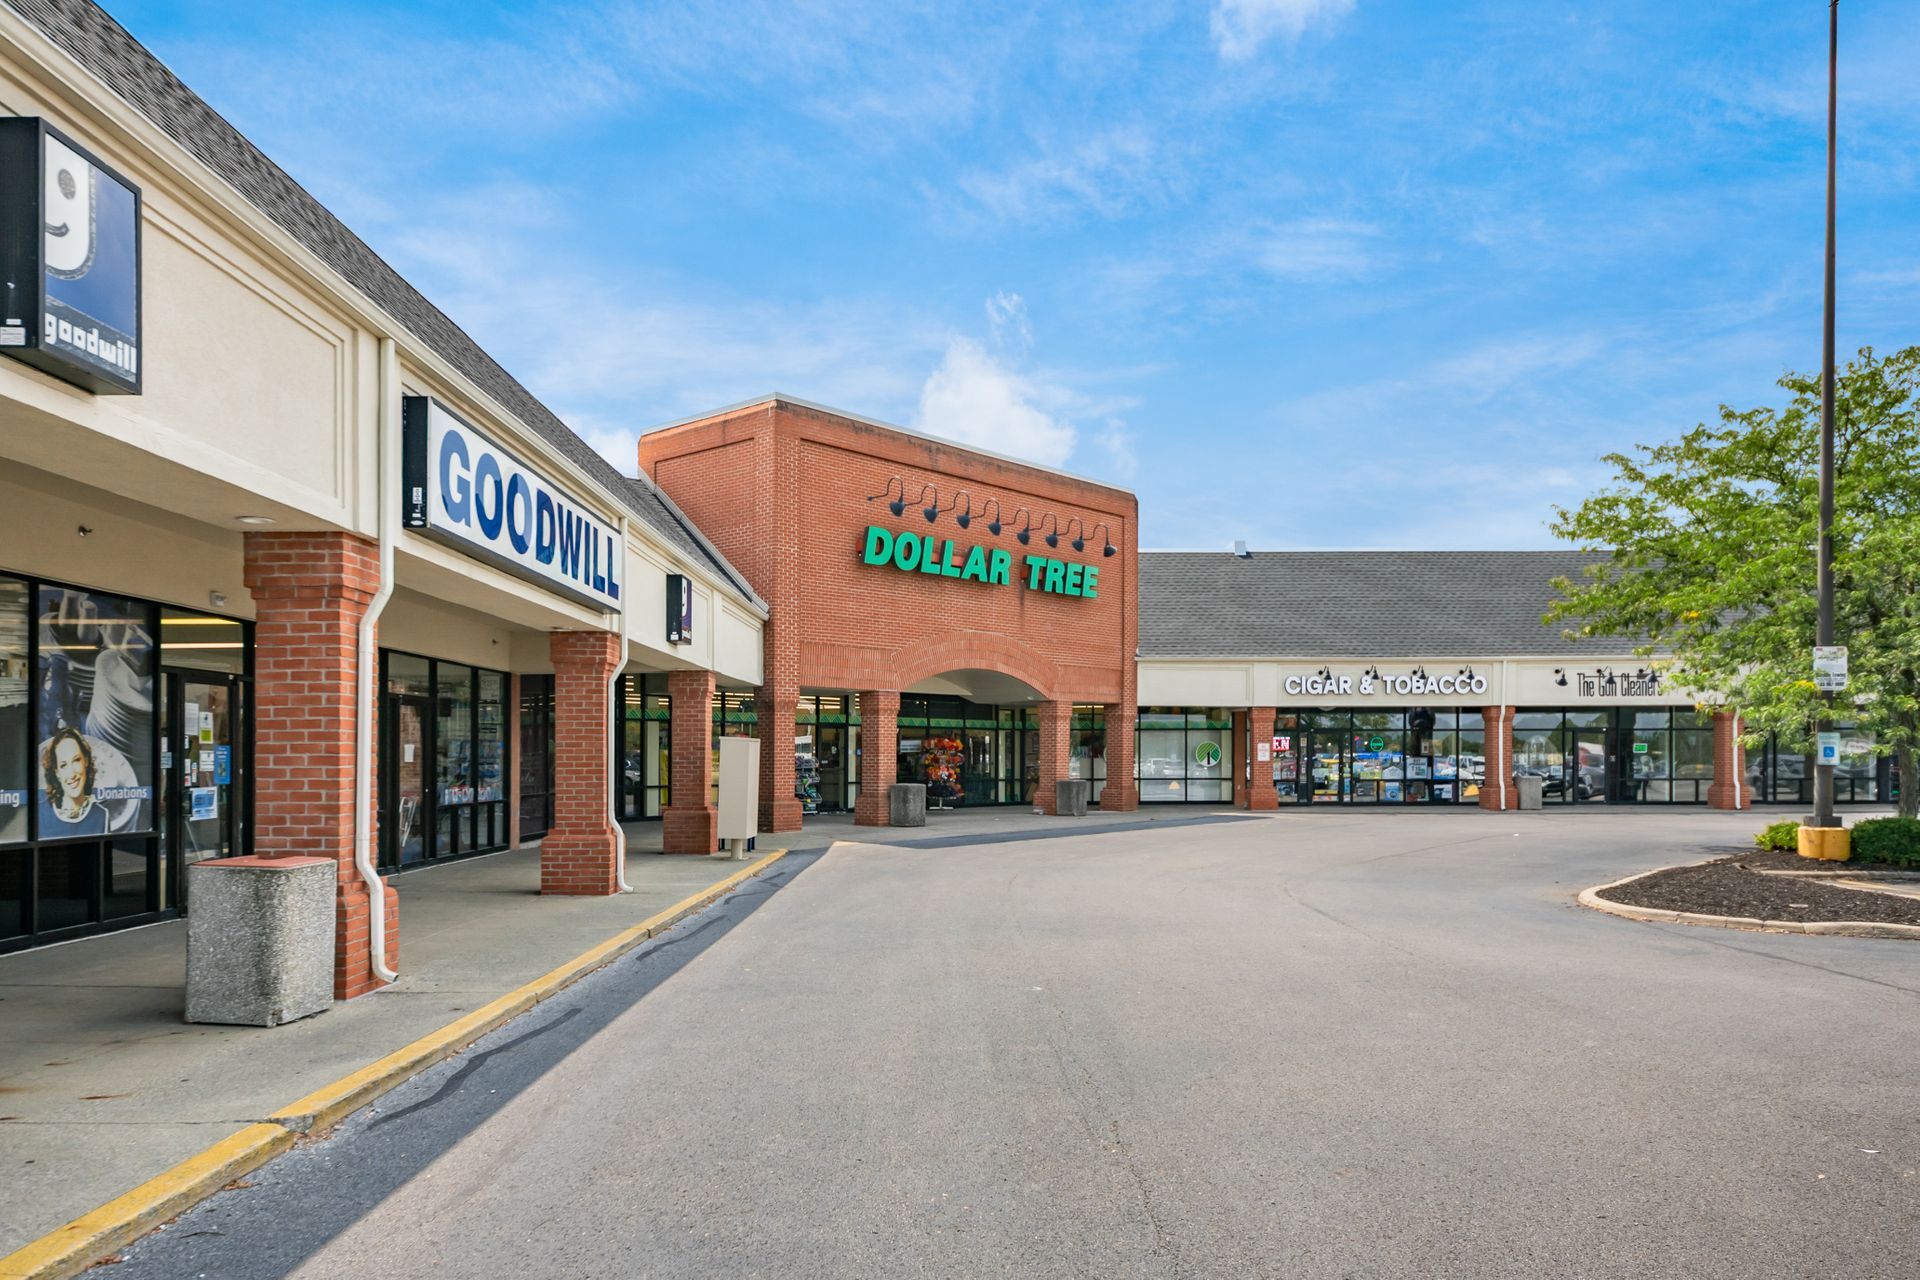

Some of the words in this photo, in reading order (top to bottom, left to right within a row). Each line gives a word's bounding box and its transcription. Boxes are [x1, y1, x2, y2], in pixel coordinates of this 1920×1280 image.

[45, 312, 137, 374] goodwill
[439, 429, 619, 601] GOODWILL
[864, 525, 1012, 586] DOLLAR
[1024, 555, 1099, 599] TREE
[1284, 675, 1353, 695] CIGAR
[1359, 676, 1375, 695] &
[1382, 675, 1488, 695] TOBACCO
[1577, 672, 1595, 697] The
[97, 788, 148, 800] Donations
